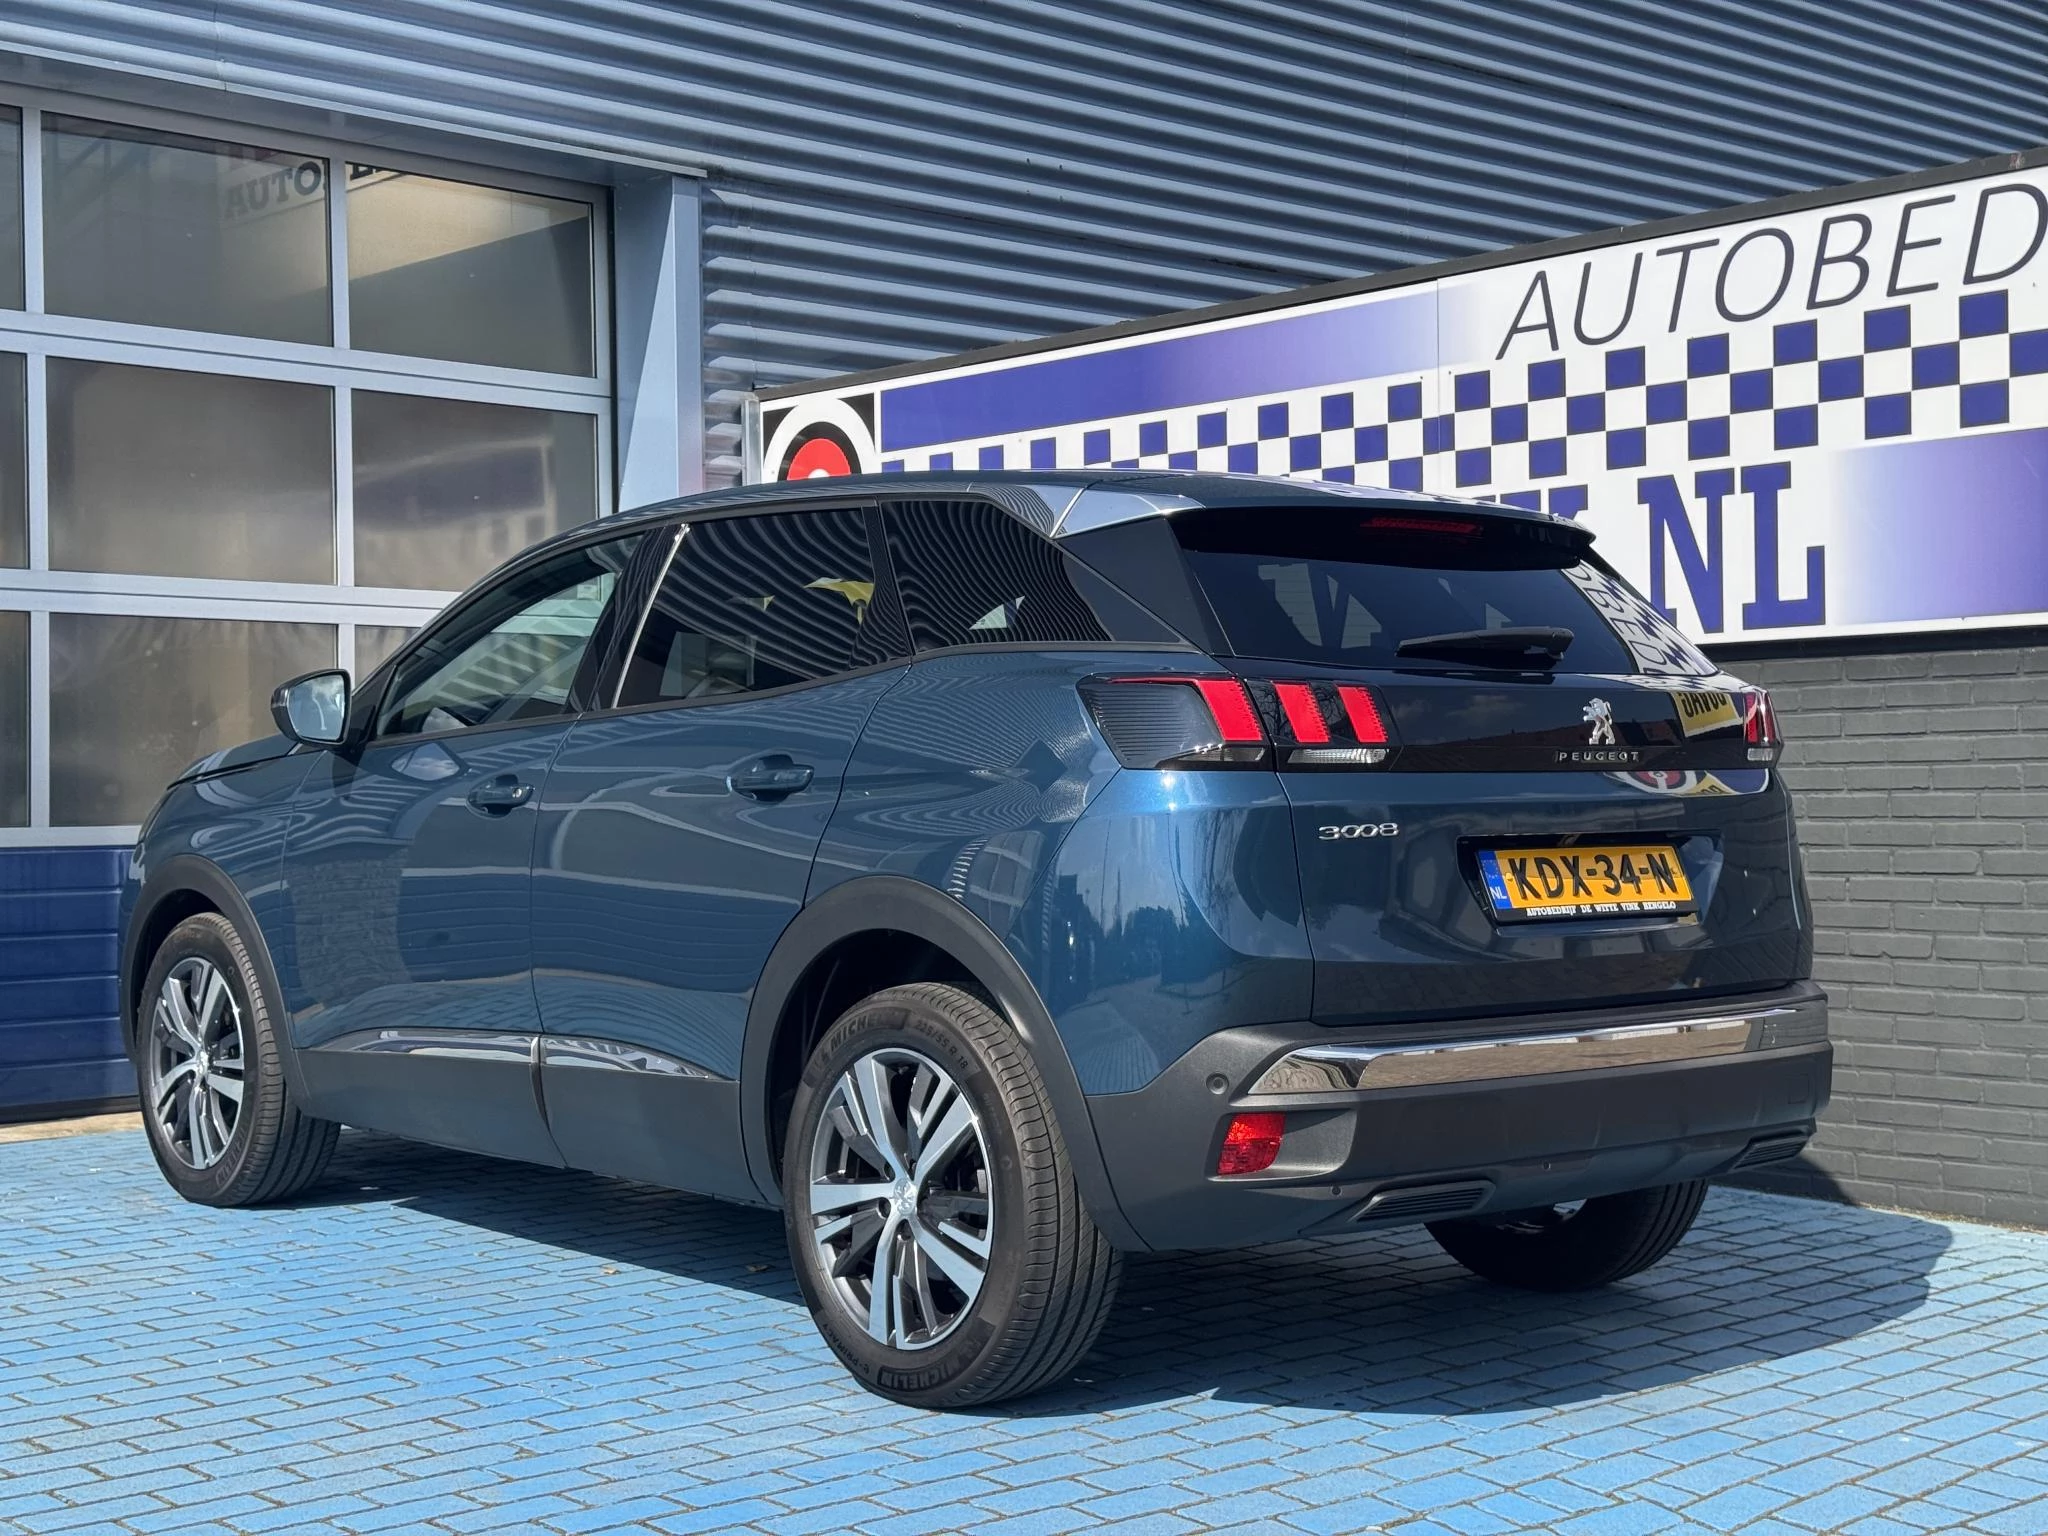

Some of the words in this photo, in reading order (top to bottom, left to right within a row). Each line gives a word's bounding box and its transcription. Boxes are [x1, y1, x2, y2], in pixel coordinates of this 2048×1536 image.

[223, 161, 322, 220] AUTO
[1495, 182, 2048, 361] AUTOBED
[1558, 751, 1639, 762] PEUGEOT
[1318, 822, 1399, 840] 3008
[1490, 886, 1507, 900] NL
[1508, 853, 1677, 900] KDX-34-N
[1580, 904, 1592, 913] DE
[1594, 902, 1619, 912] WITTE
[1620, 902, 1640, 911] VINK
[1642, 900, 1677, 910] HENGELO
